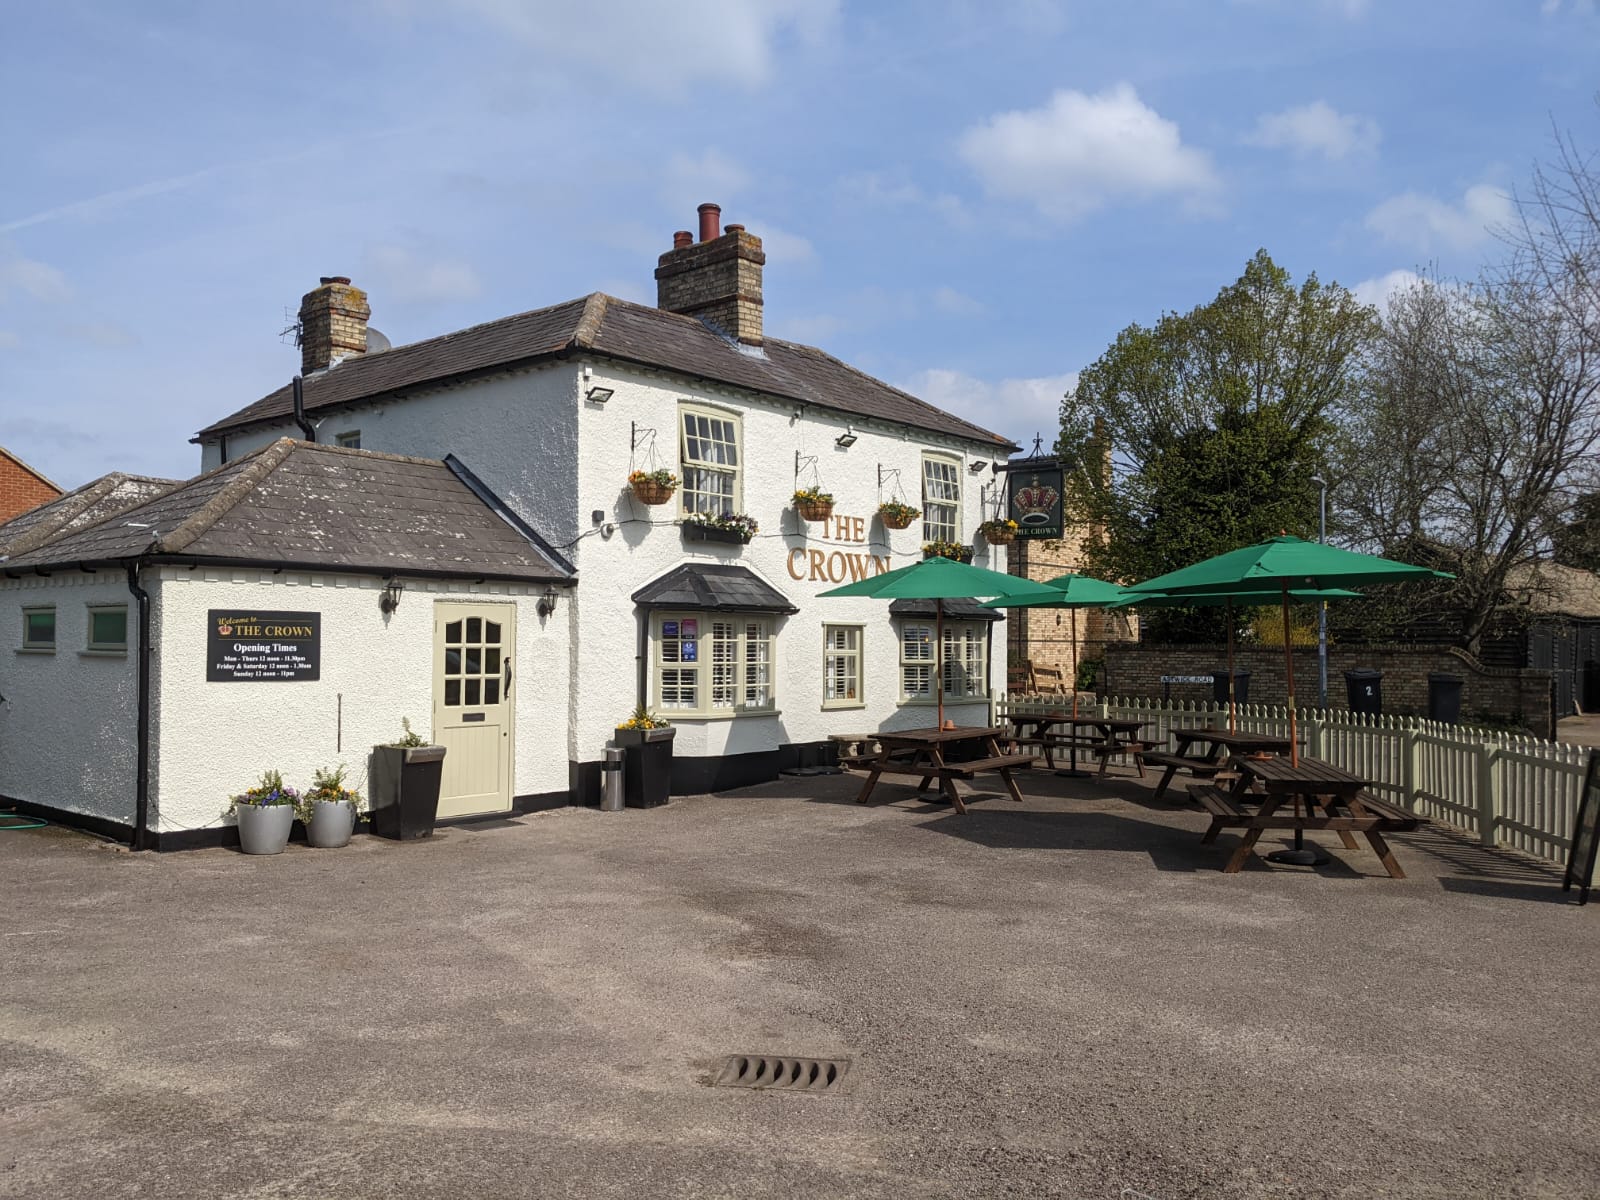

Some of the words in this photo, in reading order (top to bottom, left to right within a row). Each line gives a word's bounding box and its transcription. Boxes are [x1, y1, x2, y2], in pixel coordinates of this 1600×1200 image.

[822, 514, 865, 542] THE
[1030, 527, 1058, 535] CROWN
[786, 547, 892, 584] CROWN
[217, 617, 249, 625] Welcome
[235, 625, 262, 636] THE
[264, 625, 313, 637] CROWN
[233, 643, 271, 654] Opening
[271, 643, 297, 652] Times
[1365, 685, 1373, 696] 2
